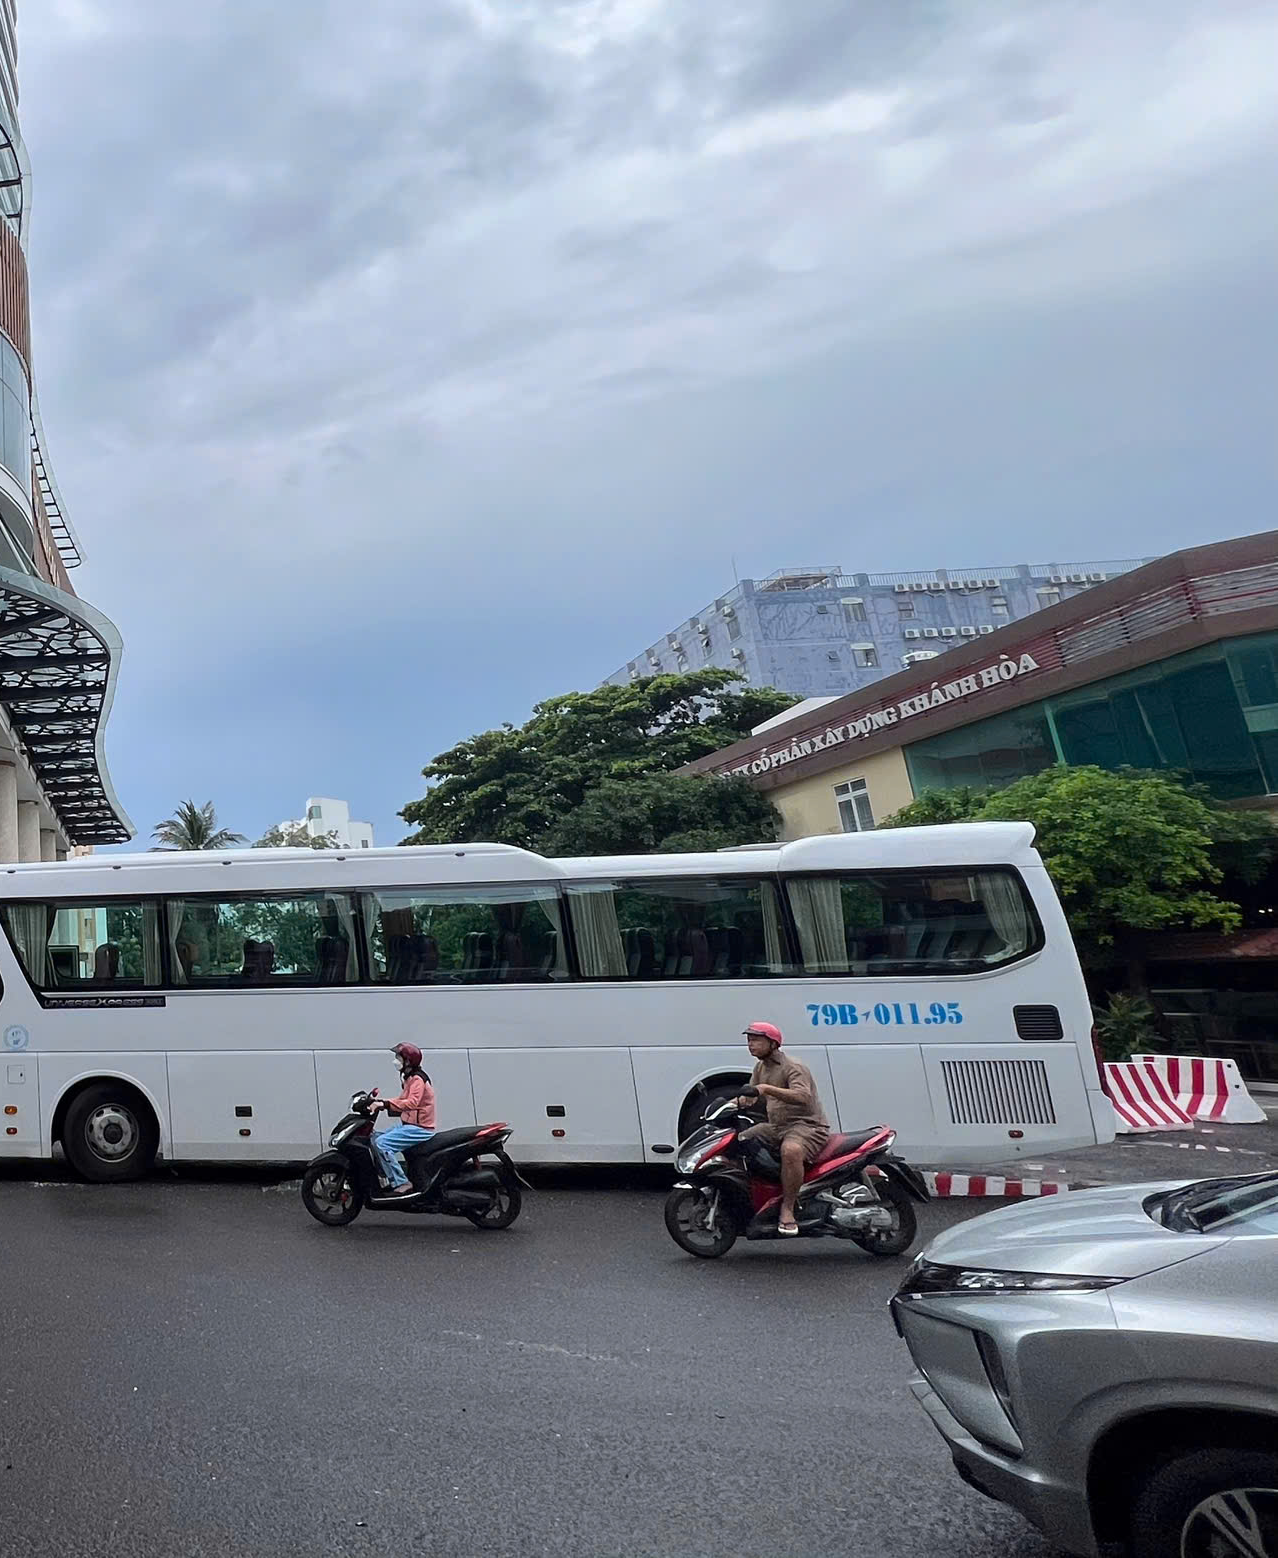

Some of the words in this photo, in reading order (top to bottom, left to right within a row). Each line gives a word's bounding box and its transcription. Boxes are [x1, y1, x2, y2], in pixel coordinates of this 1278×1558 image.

[810, 728, 847, 752] XÂY
[898, 681, 980, 719] KHÁNH
[978, 653, 1040, 688] HÒA
